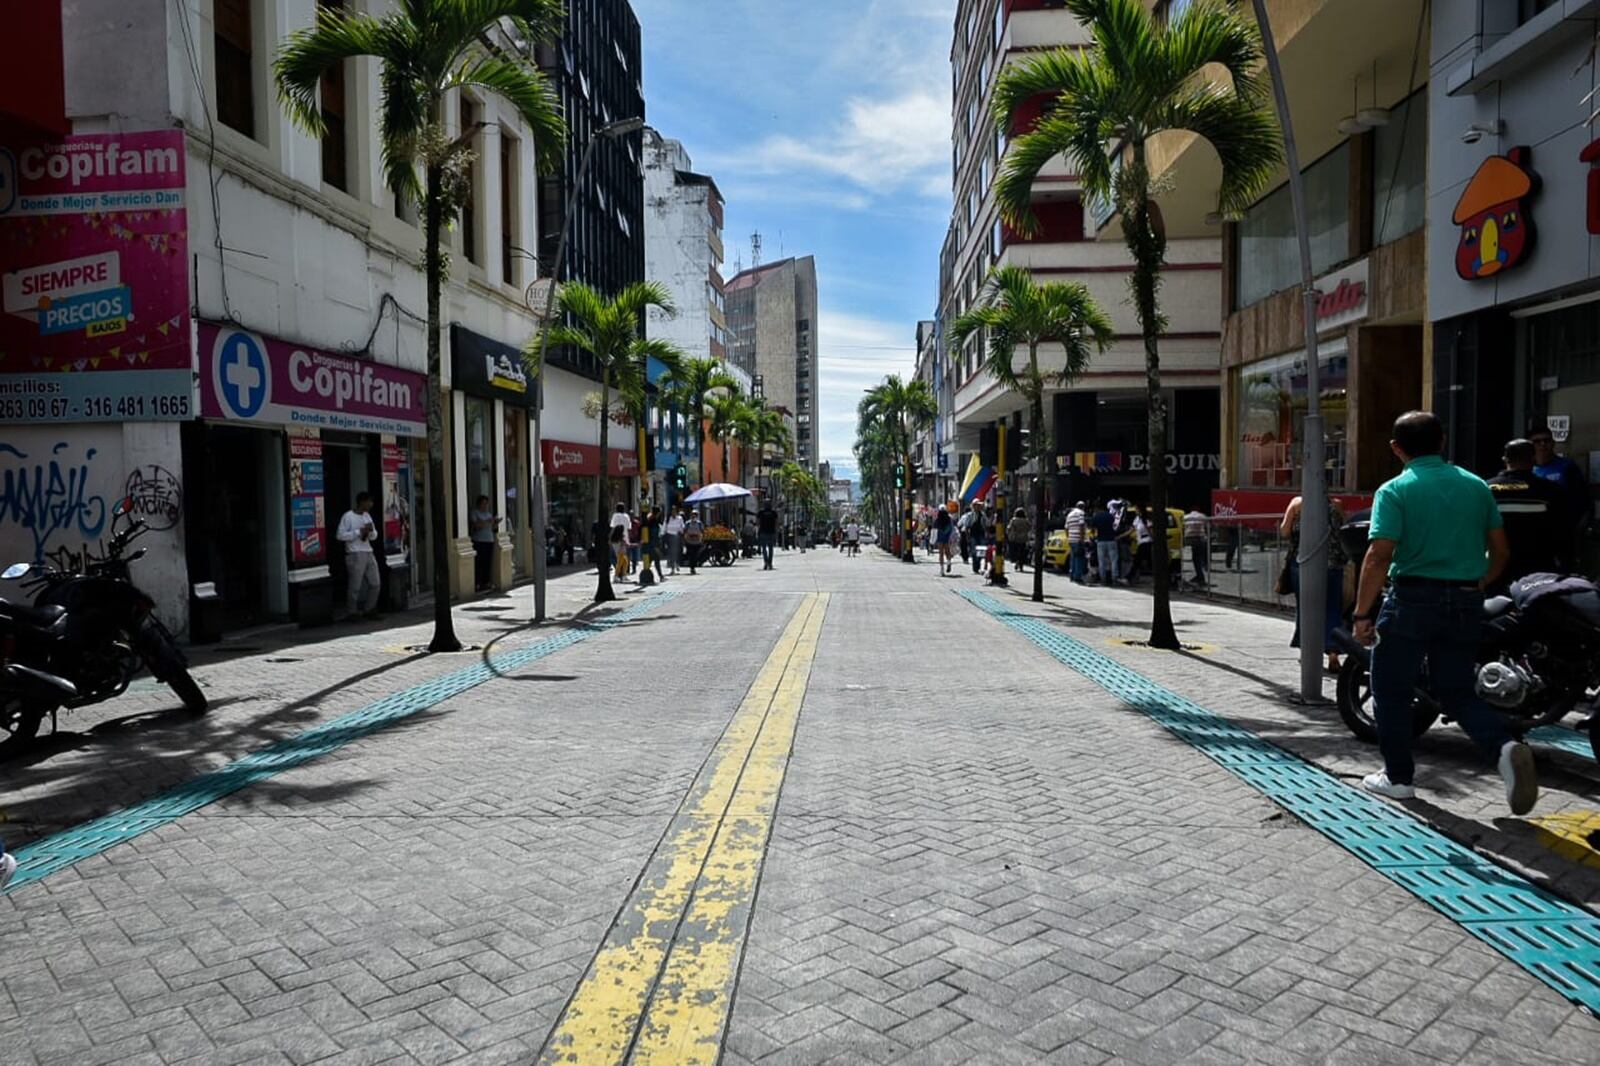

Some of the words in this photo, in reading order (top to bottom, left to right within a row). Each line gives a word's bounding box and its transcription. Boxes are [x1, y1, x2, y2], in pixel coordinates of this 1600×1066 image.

[20, 143, 179, 187] Copifam
[21, 198, 59, 211] Donde
[63, 196, 97, 209] Mejor
[101, 193, 152, 206] Servicio
[156, 192, 179, 204] Dan
[21, 262, 108, 296] SIEMPRE
[46, 297, 123, 329] PRECIOS
[91, 321, 122, 335] BAJOS
[288, 350, 411, 410] Copifam
[28, 399, 46, 418] 09
[51, 398, 68, 417] 67
[84, 397, 112, 417] 316
[117, 396, 144, 416] 481
[151, 396, 188, 415] 1665
[291, 411, 327, 423] Donde
[330, 415, 357, 428] Mejor
